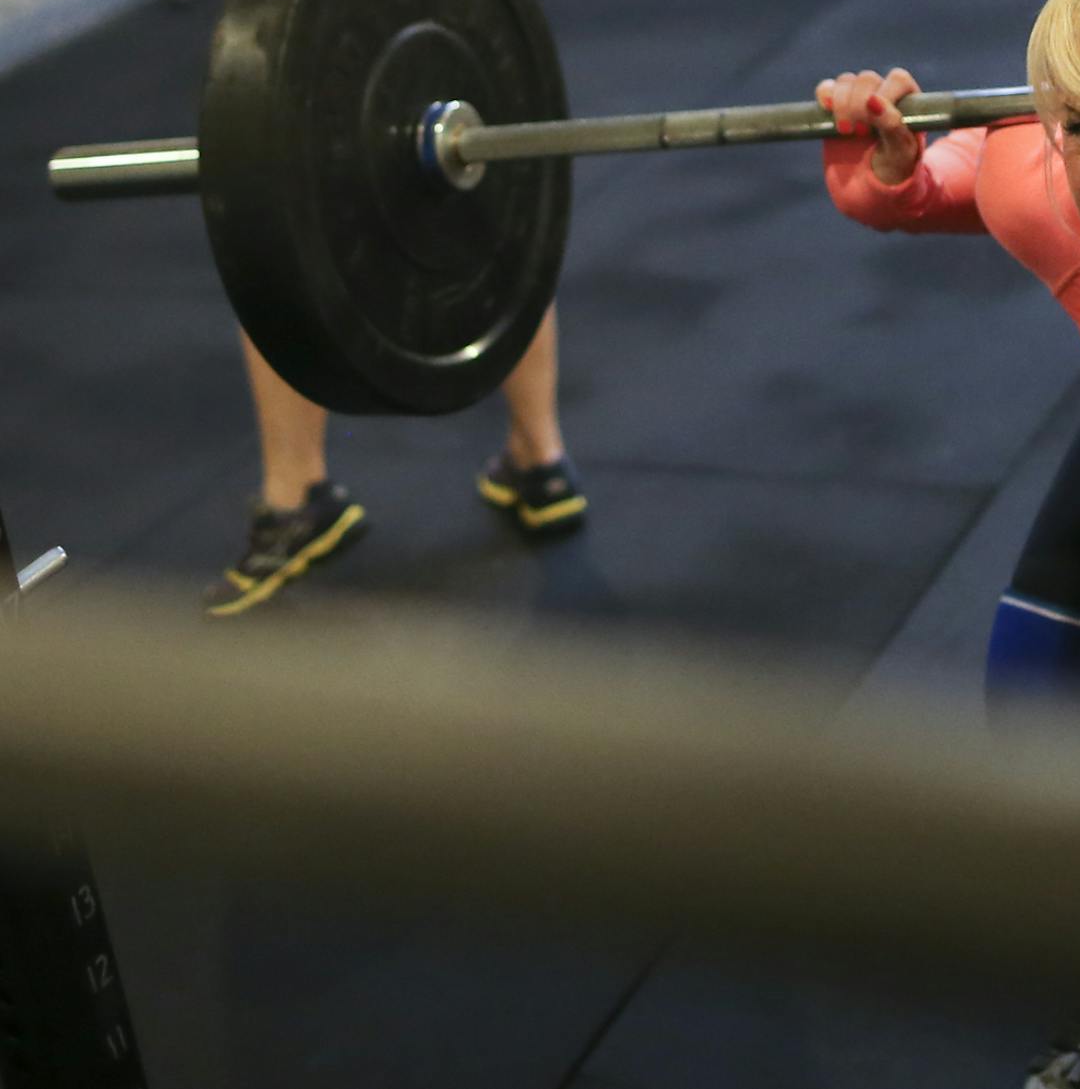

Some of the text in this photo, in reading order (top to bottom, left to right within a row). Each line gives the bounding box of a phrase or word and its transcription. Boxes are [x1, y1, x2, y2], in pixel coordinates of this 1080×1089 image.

[71, 884, 97, 927] 13
[87, 953, 114, 994] 12
[106, 1024, 128, 1060] 11
